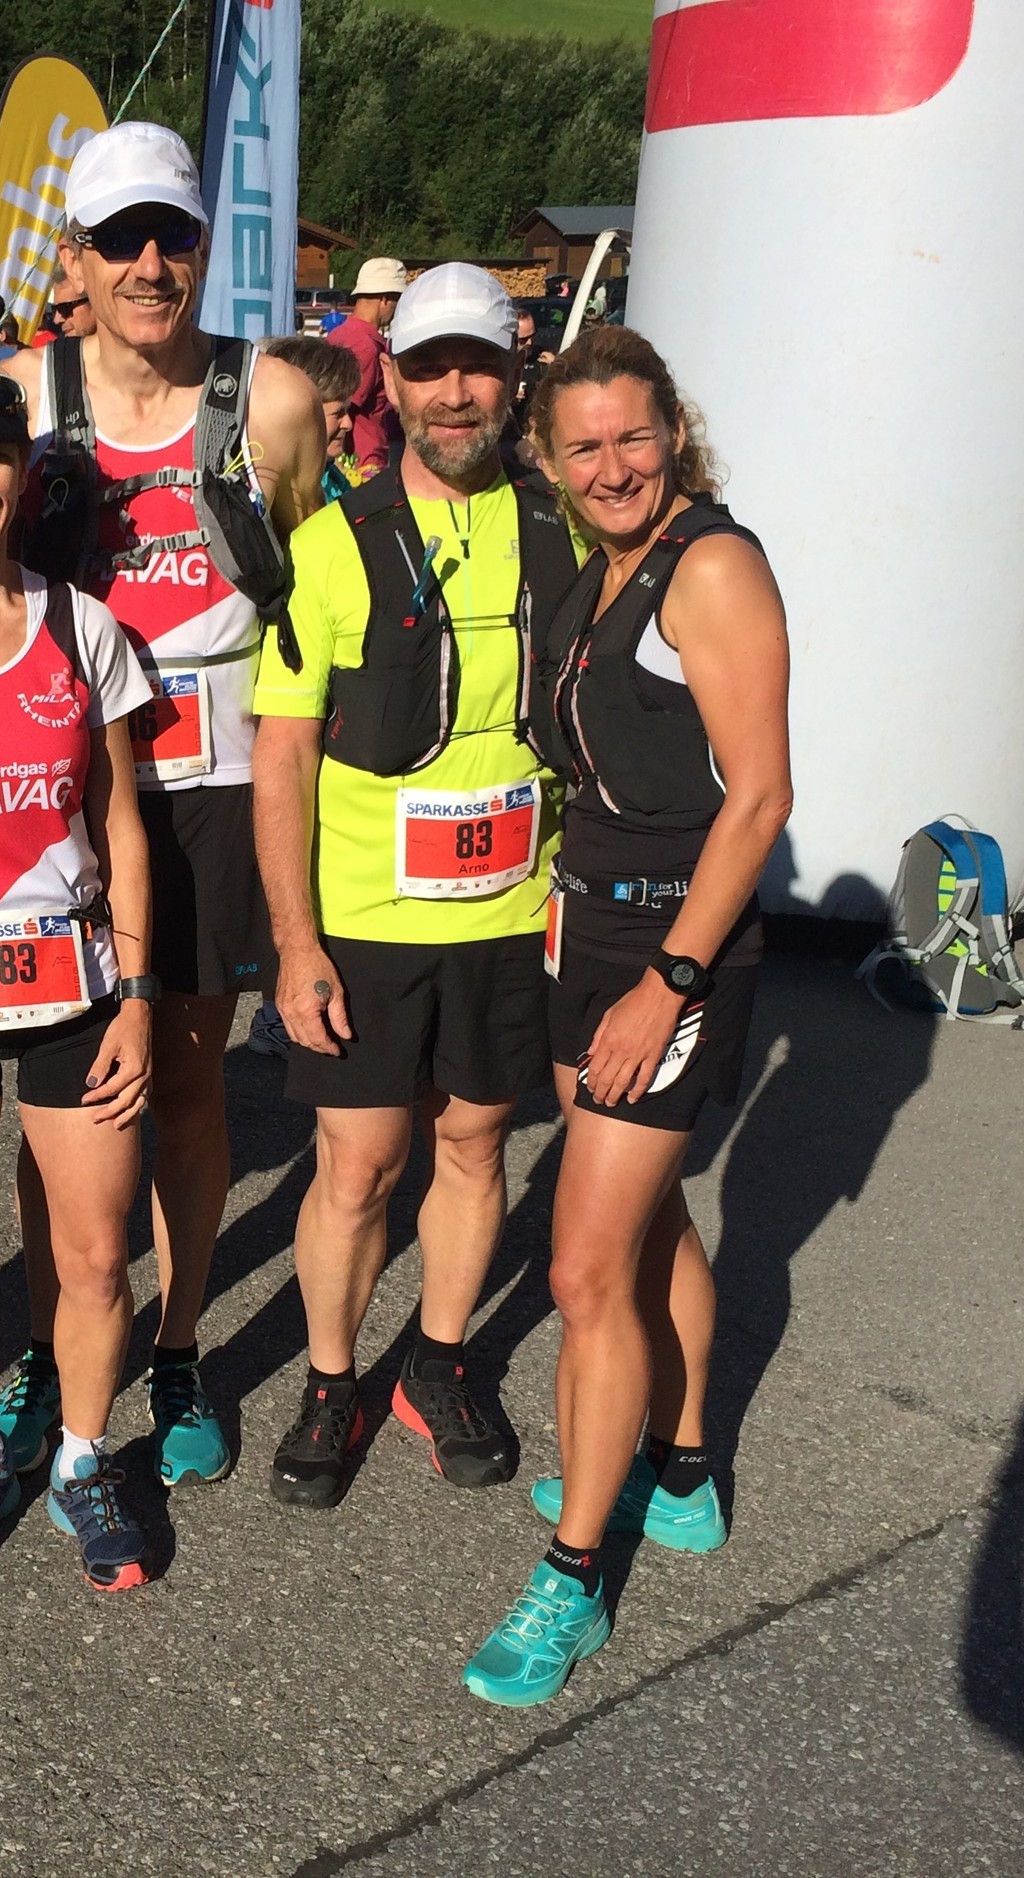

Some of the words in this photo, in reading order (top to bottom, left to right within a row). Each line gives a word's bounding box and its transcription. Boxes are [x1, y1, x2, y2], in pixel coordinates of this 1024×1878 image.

[406, 802, 489, 817] SPARKASSE
[456, 820, 493, 859] 83
[458, 862, 490, 875] Arno
[673, 880, 689, 897] li
